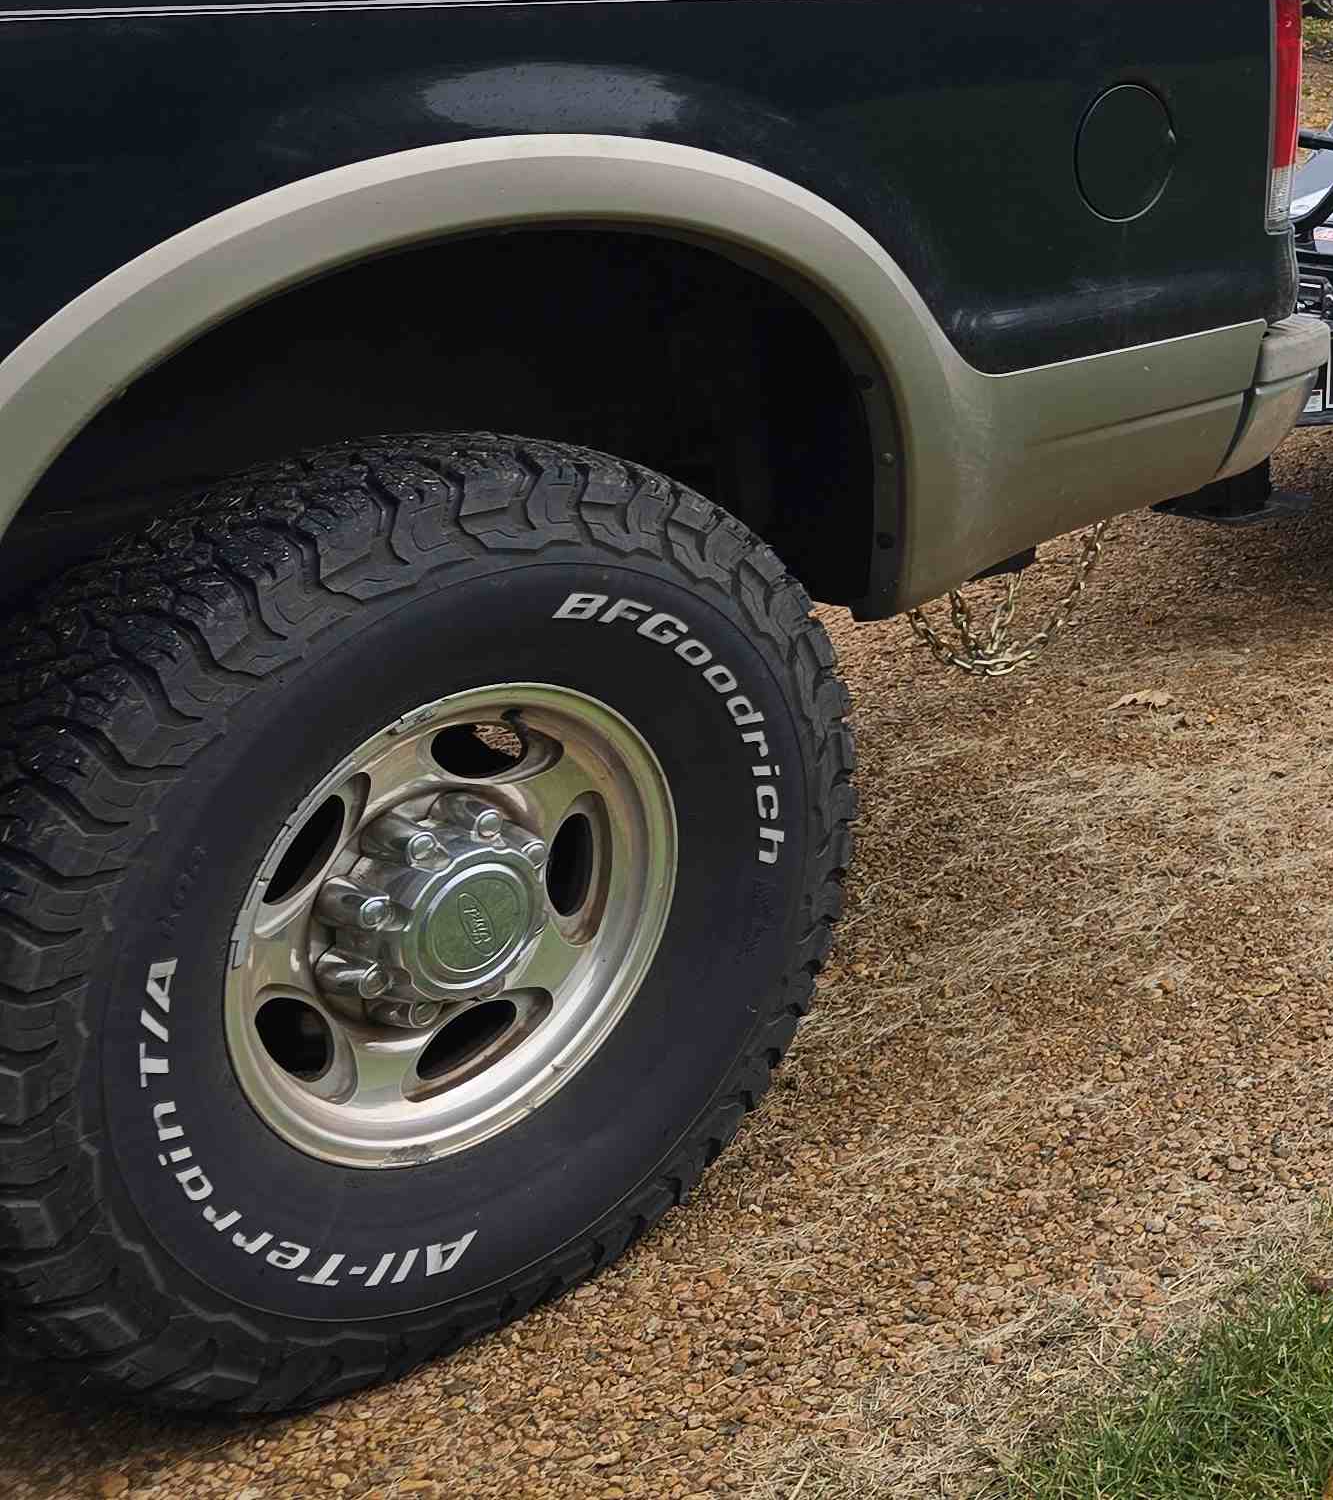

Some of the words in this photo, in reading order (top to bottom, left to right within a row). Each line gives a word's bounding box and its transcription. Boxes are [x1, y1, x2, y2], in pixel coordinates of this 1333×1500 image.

[551, 591, 786, 866] BFGoodrich
[138, 956, 180, 1088] T/A
[152, 1100, 478, 1288] All-Terrain
